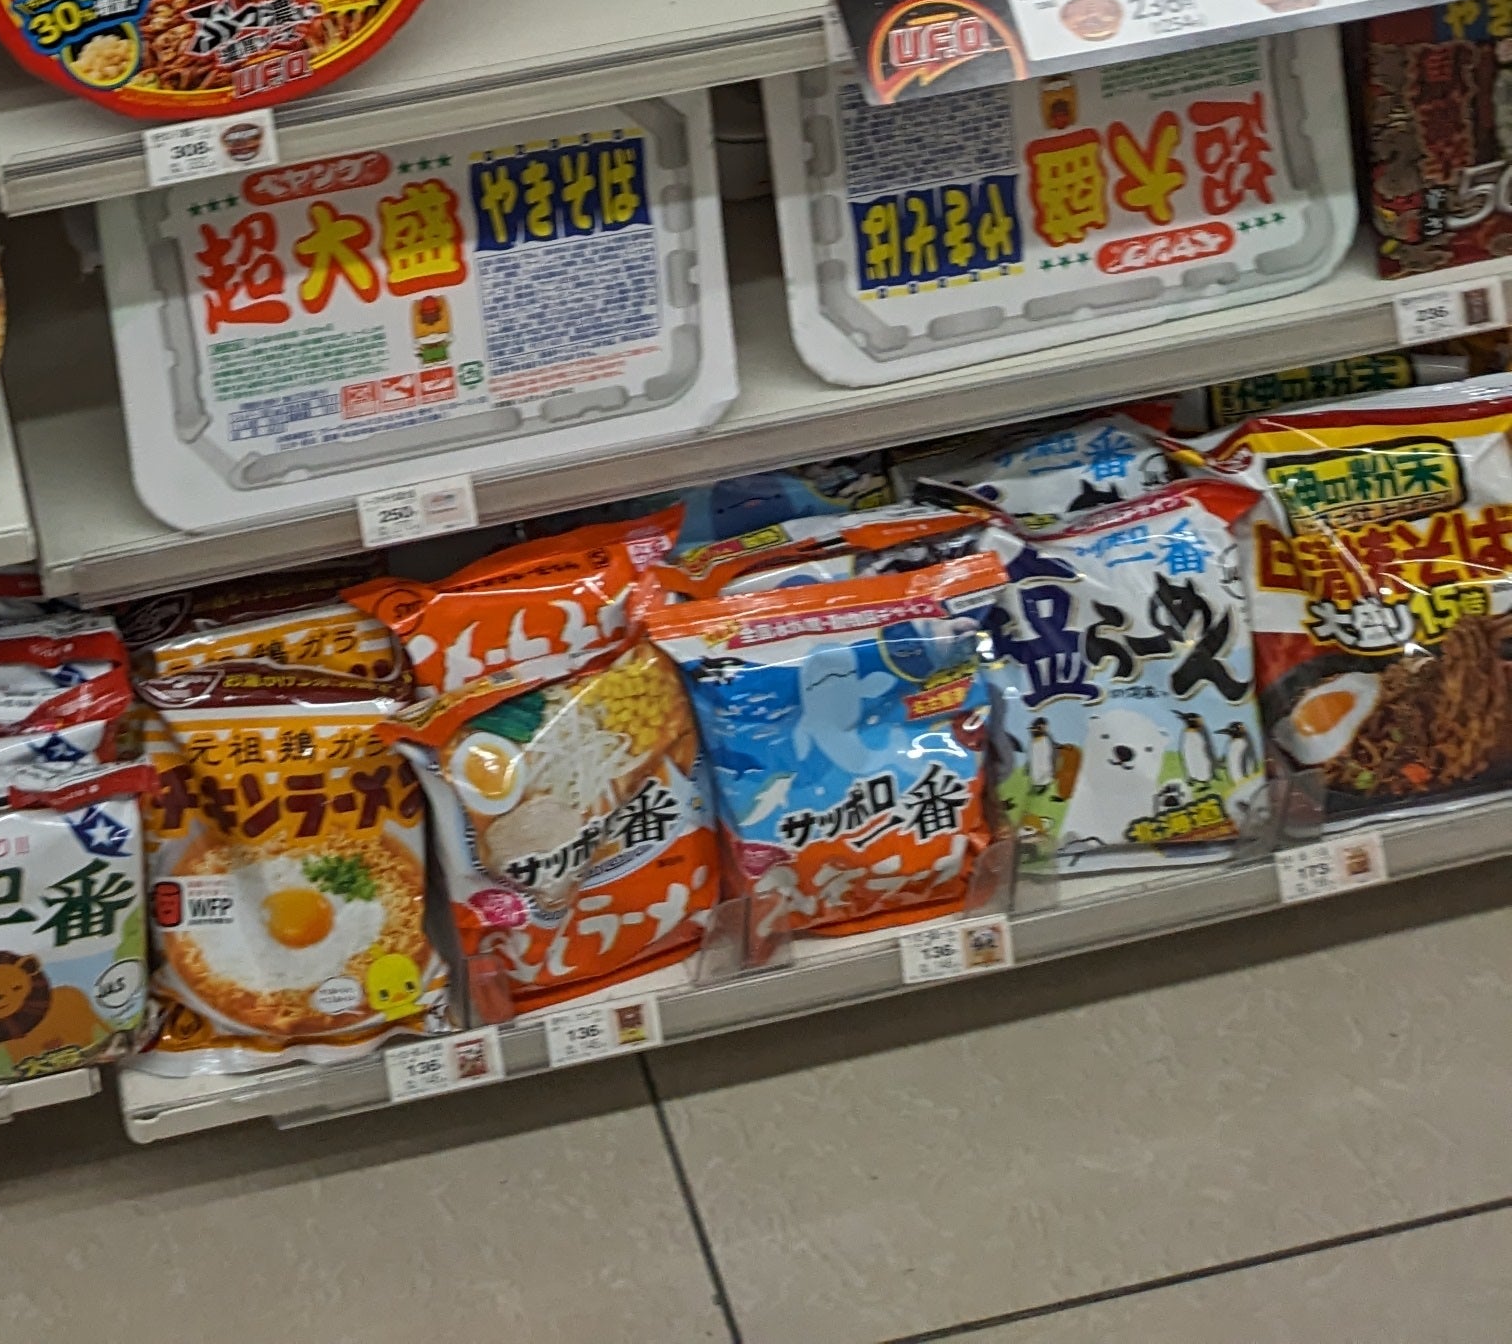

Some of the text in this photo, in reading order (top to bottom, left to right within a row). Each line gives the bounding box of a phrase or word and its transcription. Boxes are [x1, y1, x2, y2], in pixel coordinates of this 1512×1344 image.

[245, 157, 387, 202] ペヤング
[480, 147, 644, 245] やきそば
[1026, 90, 1276, 248] 超大盛
[197, 180, 469, 334] 超大盛
[860, 186, 1015, 284] やきそば
[1105, 227, 1229, 272] ペヤング
[1278, 446, 1452, 511] 神の粉末
[1078, 517, 1212, 575] サッポロ一番
[1259, 509, 1512, 600] 日清焼そば
[191, 729, 385, 767] 元祖鶏ガラ
[784, 765, 968, 851] サッポロ一番
[1125, 795, 1224, 842] 北海道
[189, 896, 235, 919] WFP
[566, 1024, 601, 1041] 136
[406, 1059, 441, 1077] 136
